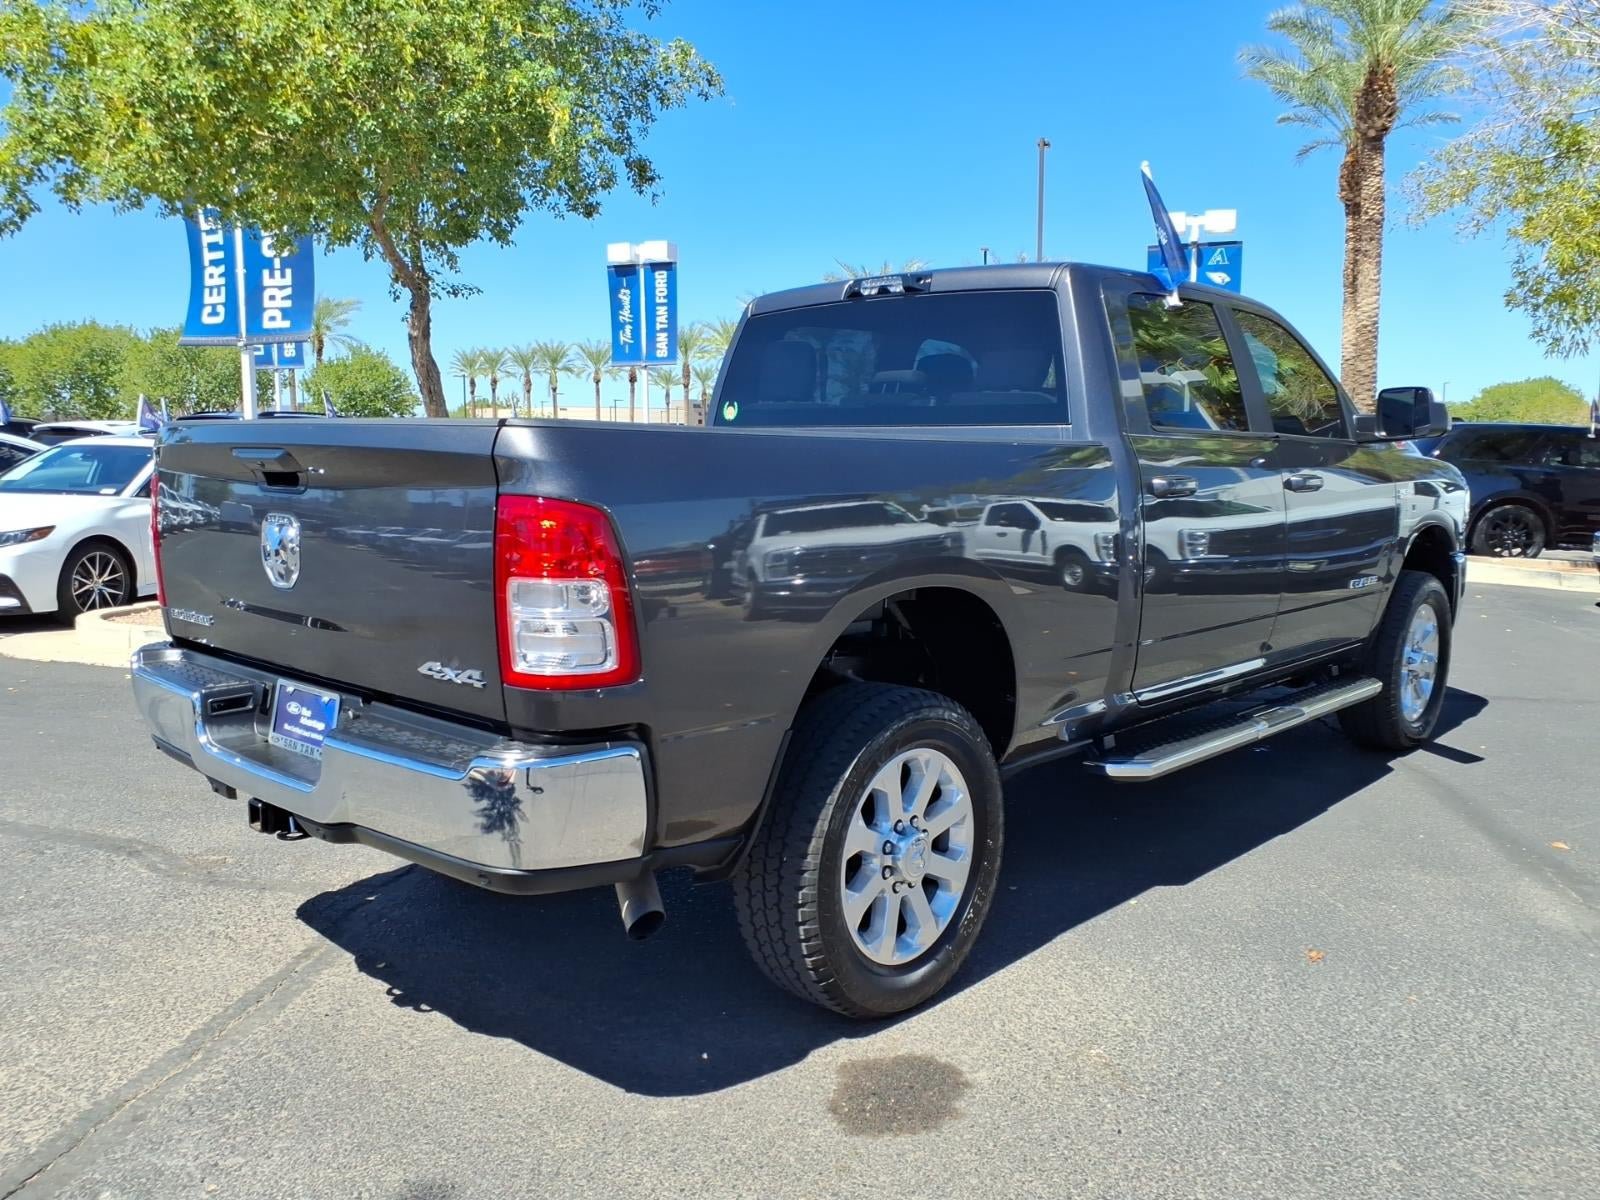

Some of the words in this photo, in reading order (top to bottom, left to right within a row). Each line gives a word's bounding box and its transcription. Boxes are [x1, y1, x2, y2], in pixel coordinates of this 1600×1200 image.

[654, 270, 668, 303] FORD
[656, 305, 668, 331] TAN
[619, 324, 634, 346] Tim
[656, 332, 668, 358] SAN
